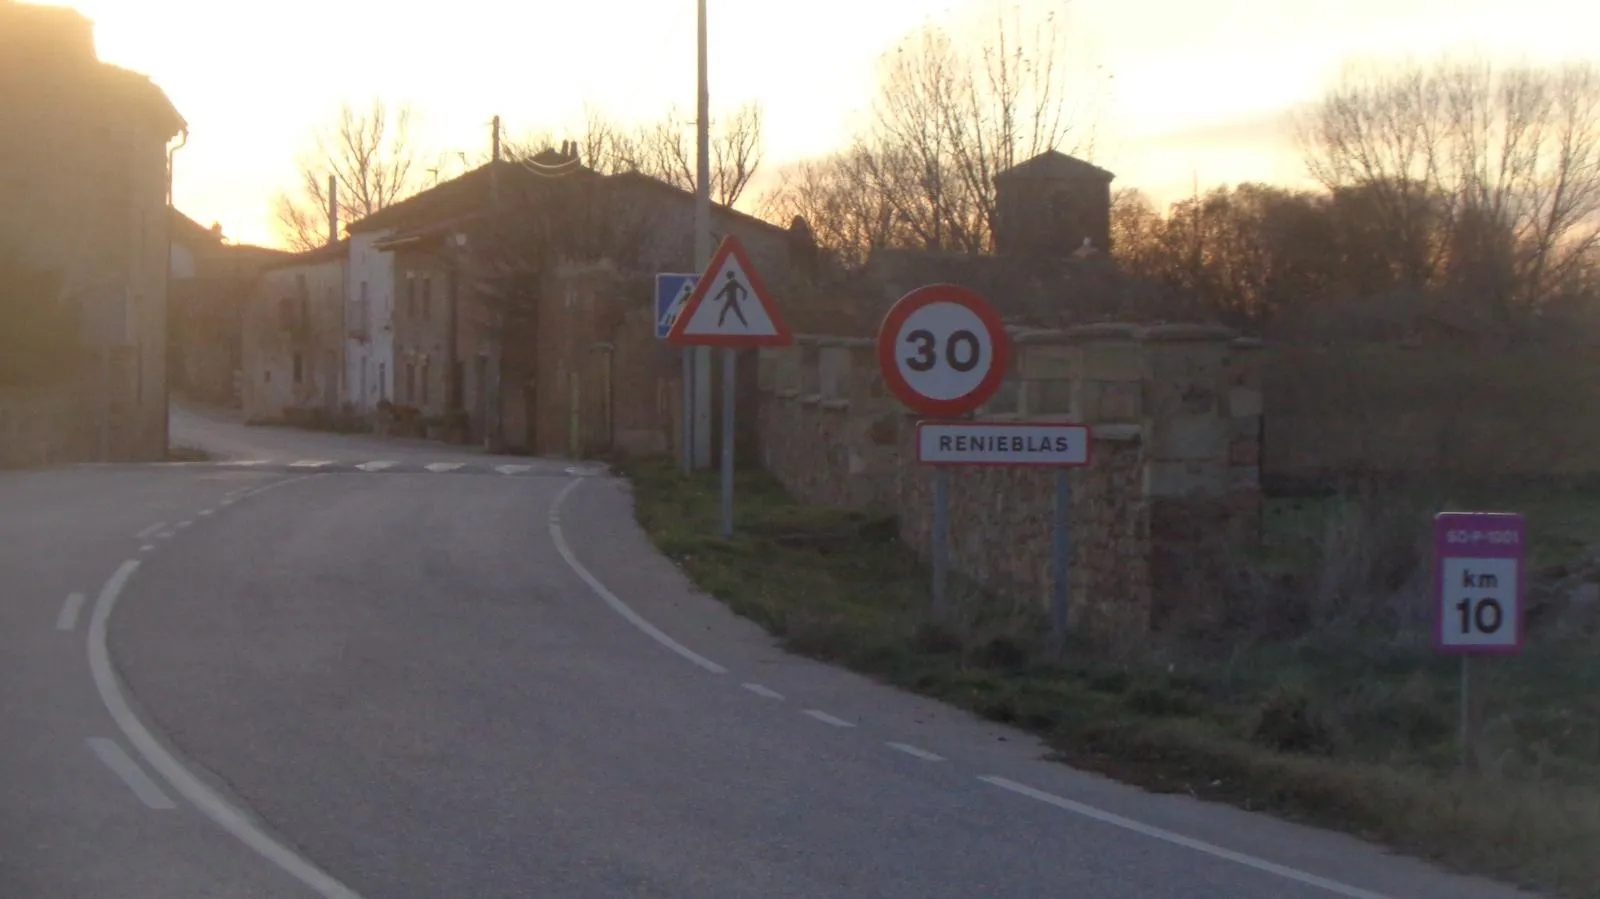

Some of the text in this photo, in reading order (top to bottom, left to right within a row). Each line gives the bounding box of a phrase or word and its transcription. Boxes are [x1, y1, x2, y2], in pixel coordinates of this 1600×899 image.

[905, 329, 981, 373] 30
[939, 435, 1069, 453] RENIEBLAS
[1463, 569, 1498, 588] km
[1455, 597, 1504, 634] 10
